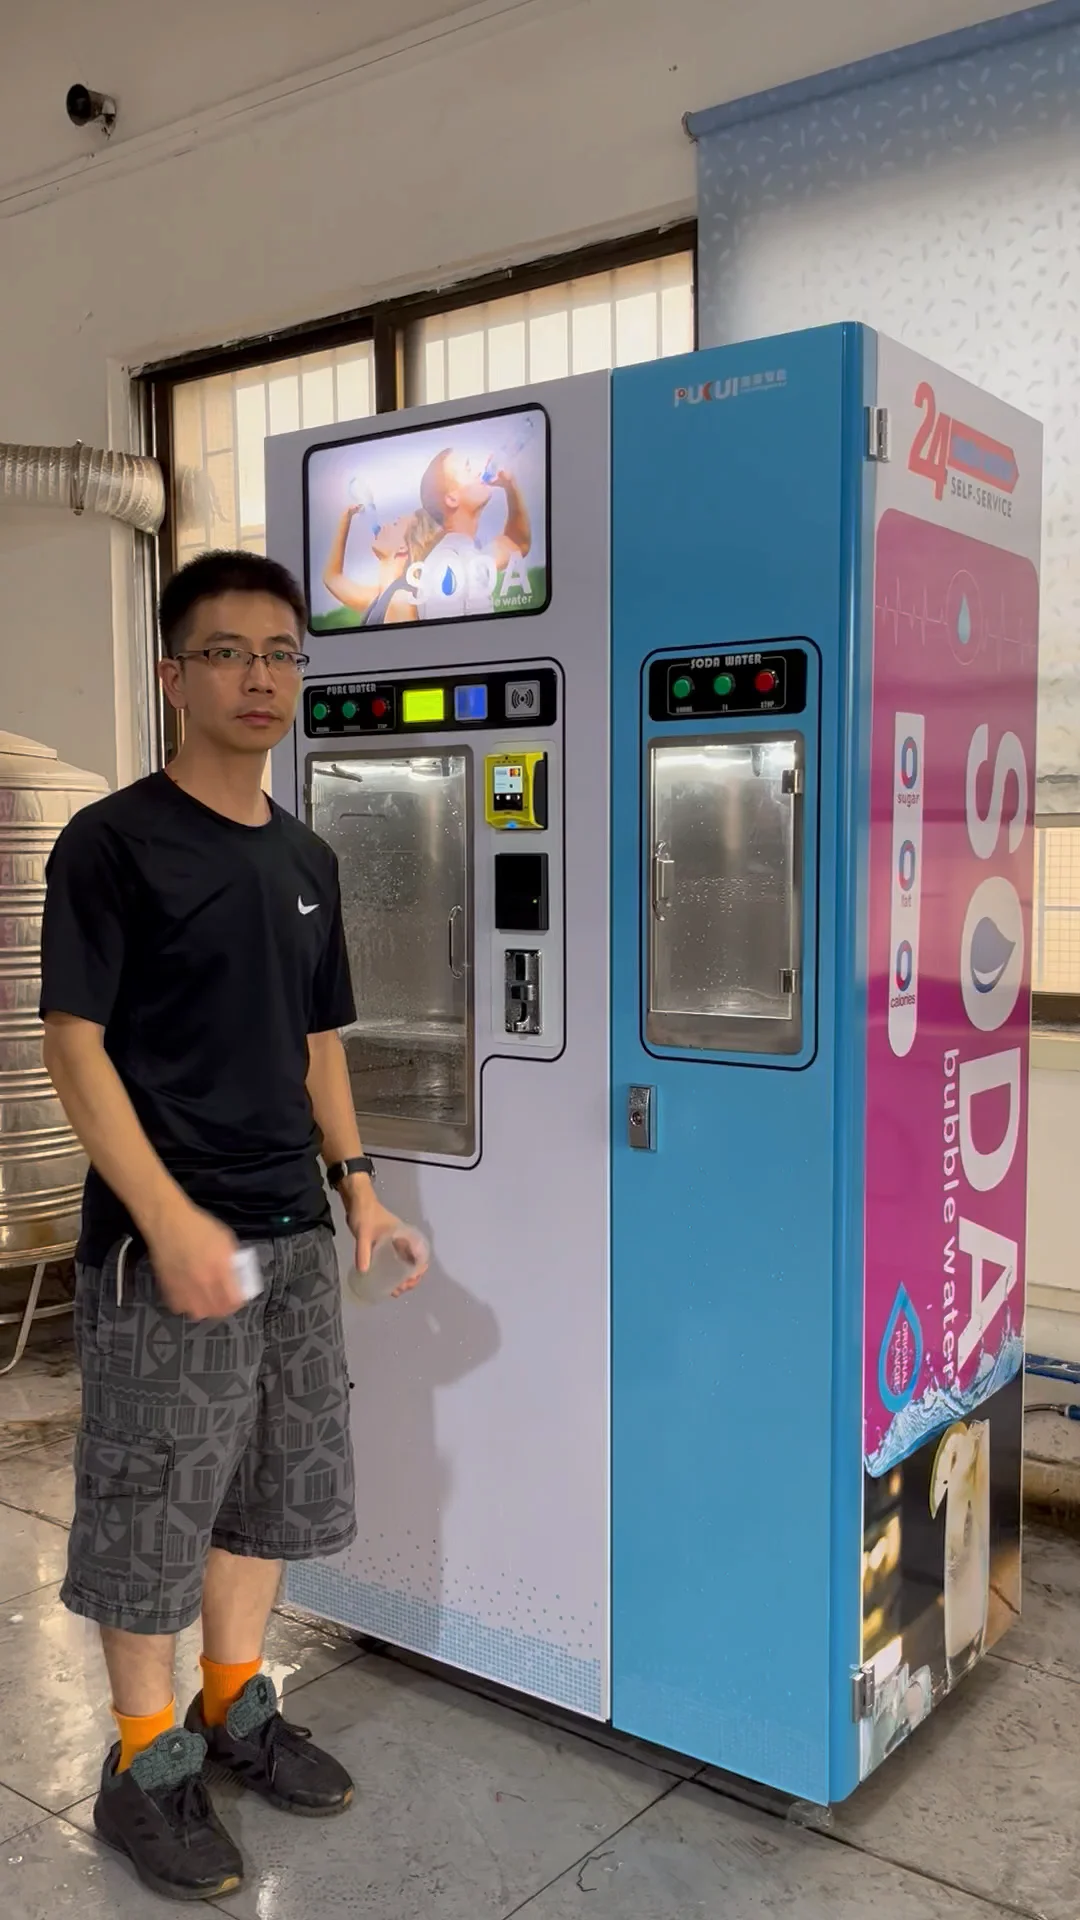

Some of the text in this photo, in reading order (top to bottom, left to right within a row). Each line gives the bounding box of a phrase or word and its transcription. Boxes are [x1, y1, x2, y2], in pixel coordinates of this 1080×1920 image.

[907, 381, 948, 502] 24
[502, 593, 533, 606] water
[690, 653, 762, 669] SODA WATER
[326, 683, 377, 696] PURE WATER
[897, 793, 921, 807] sugar
[890, 994, 916, 1008] calories
[959, 724, 1028, 1373] SODA
[943, 1048, 960, 1380] bubble water
